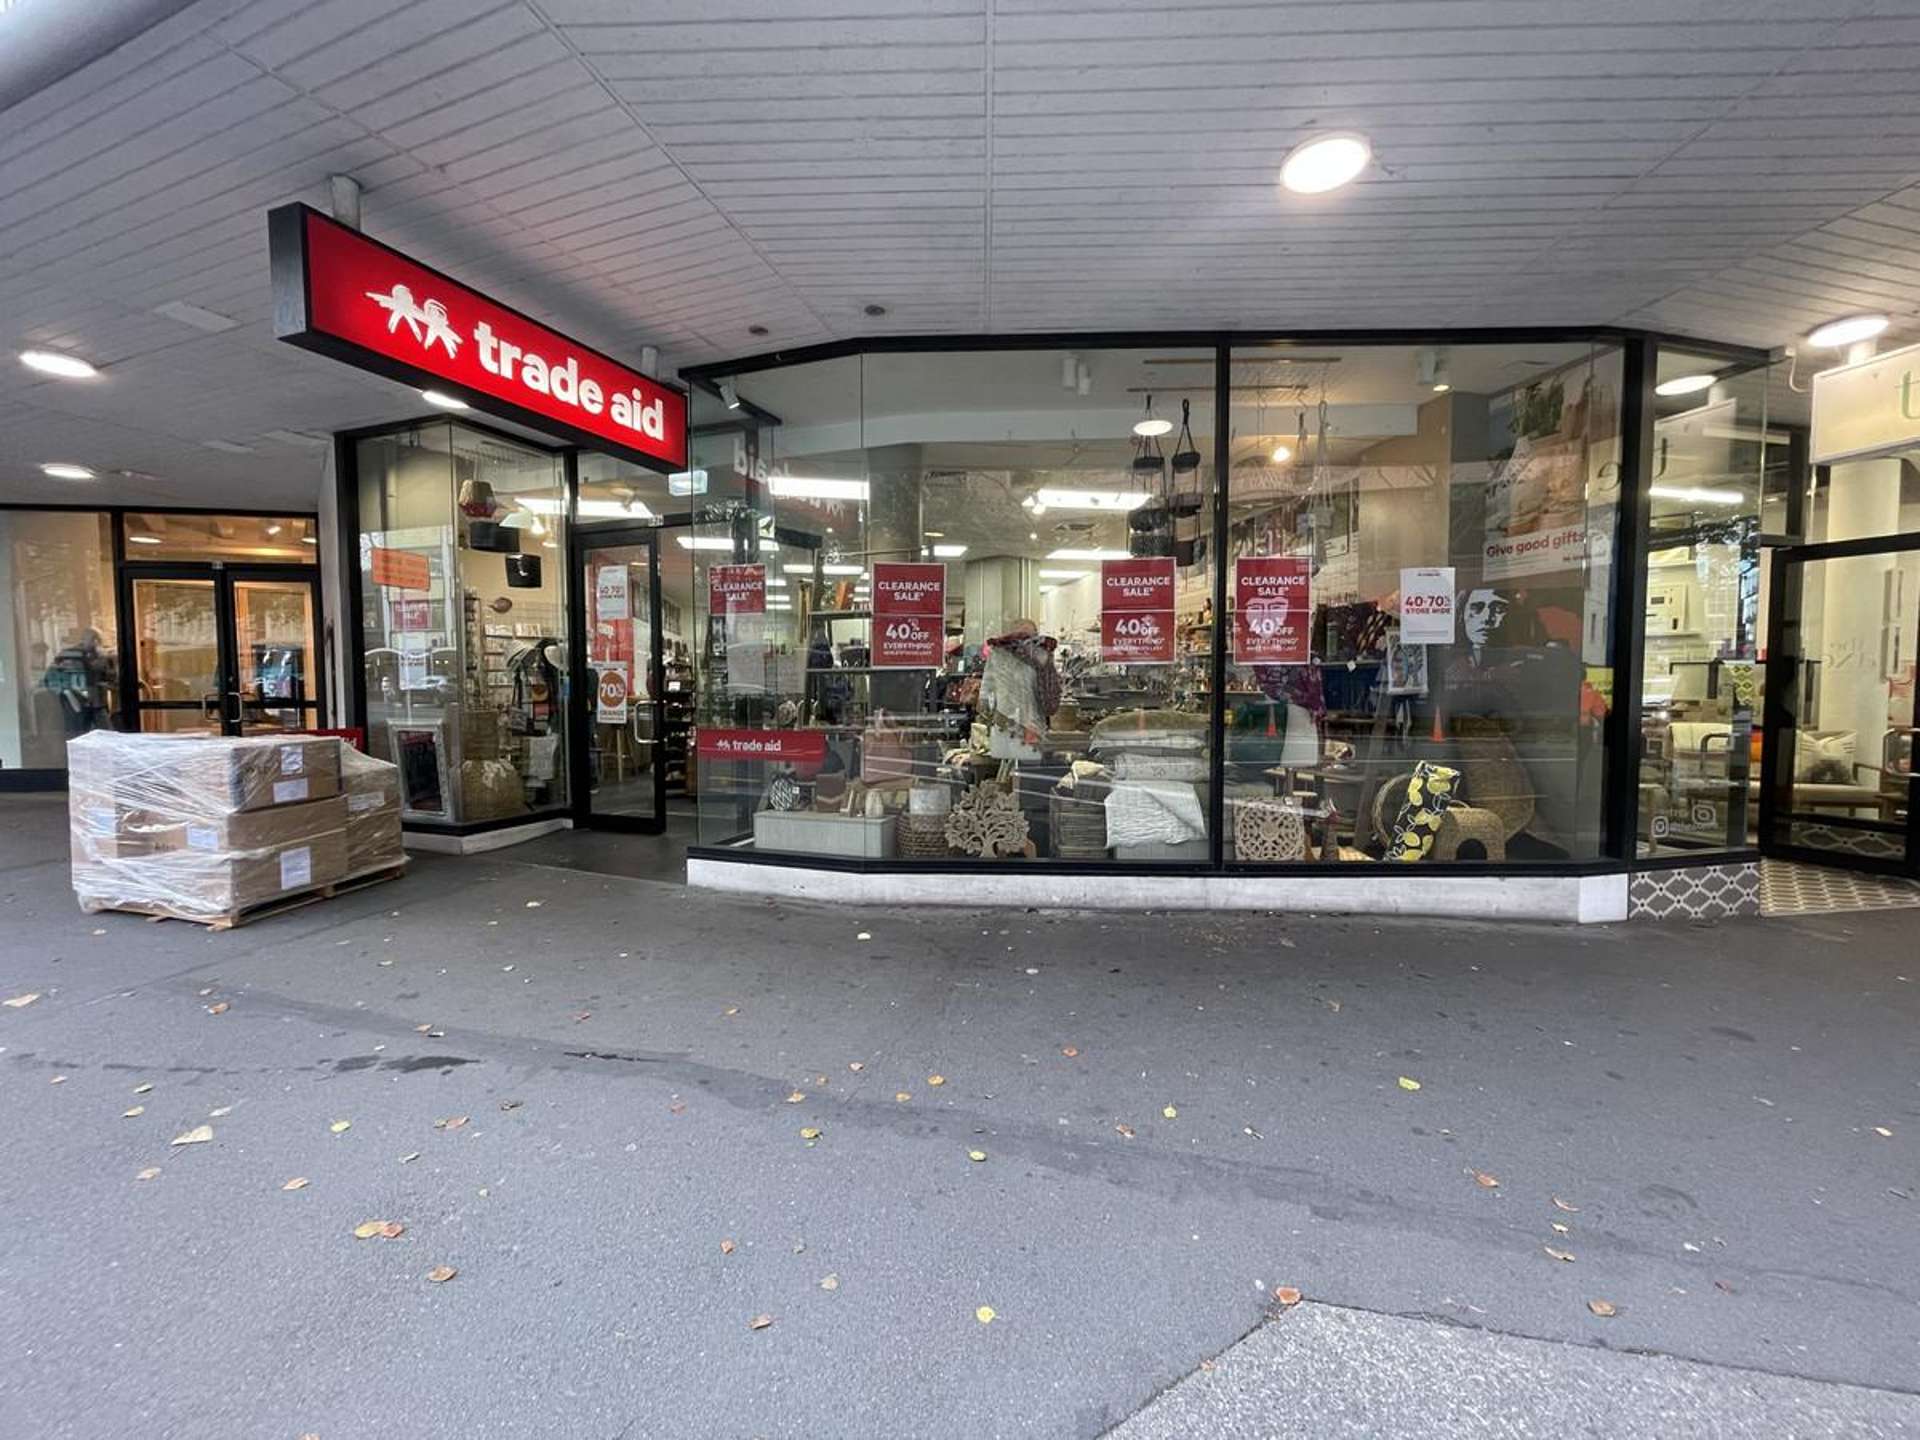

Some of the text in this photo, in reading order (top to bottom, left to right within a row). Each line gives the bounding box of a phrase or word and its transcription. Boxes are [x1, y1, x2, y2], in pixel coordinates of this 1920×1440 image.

[474, 320, 665, 442] trade aid
[1487, 530, 1586, 558] Give good gifts
[1106, 576, 1171, 587] CLEARANCE
[1241, 575, 1306, 586] CLEARANCE
[713, 582, 763, 593] CLEARANCE
[878, 581, 941, 592] CLEARANCE
[911, 631, 929, 641] OFF
[1140, 626, 1161, 637] OFF
[732, 739, 782, 752] trade aid
